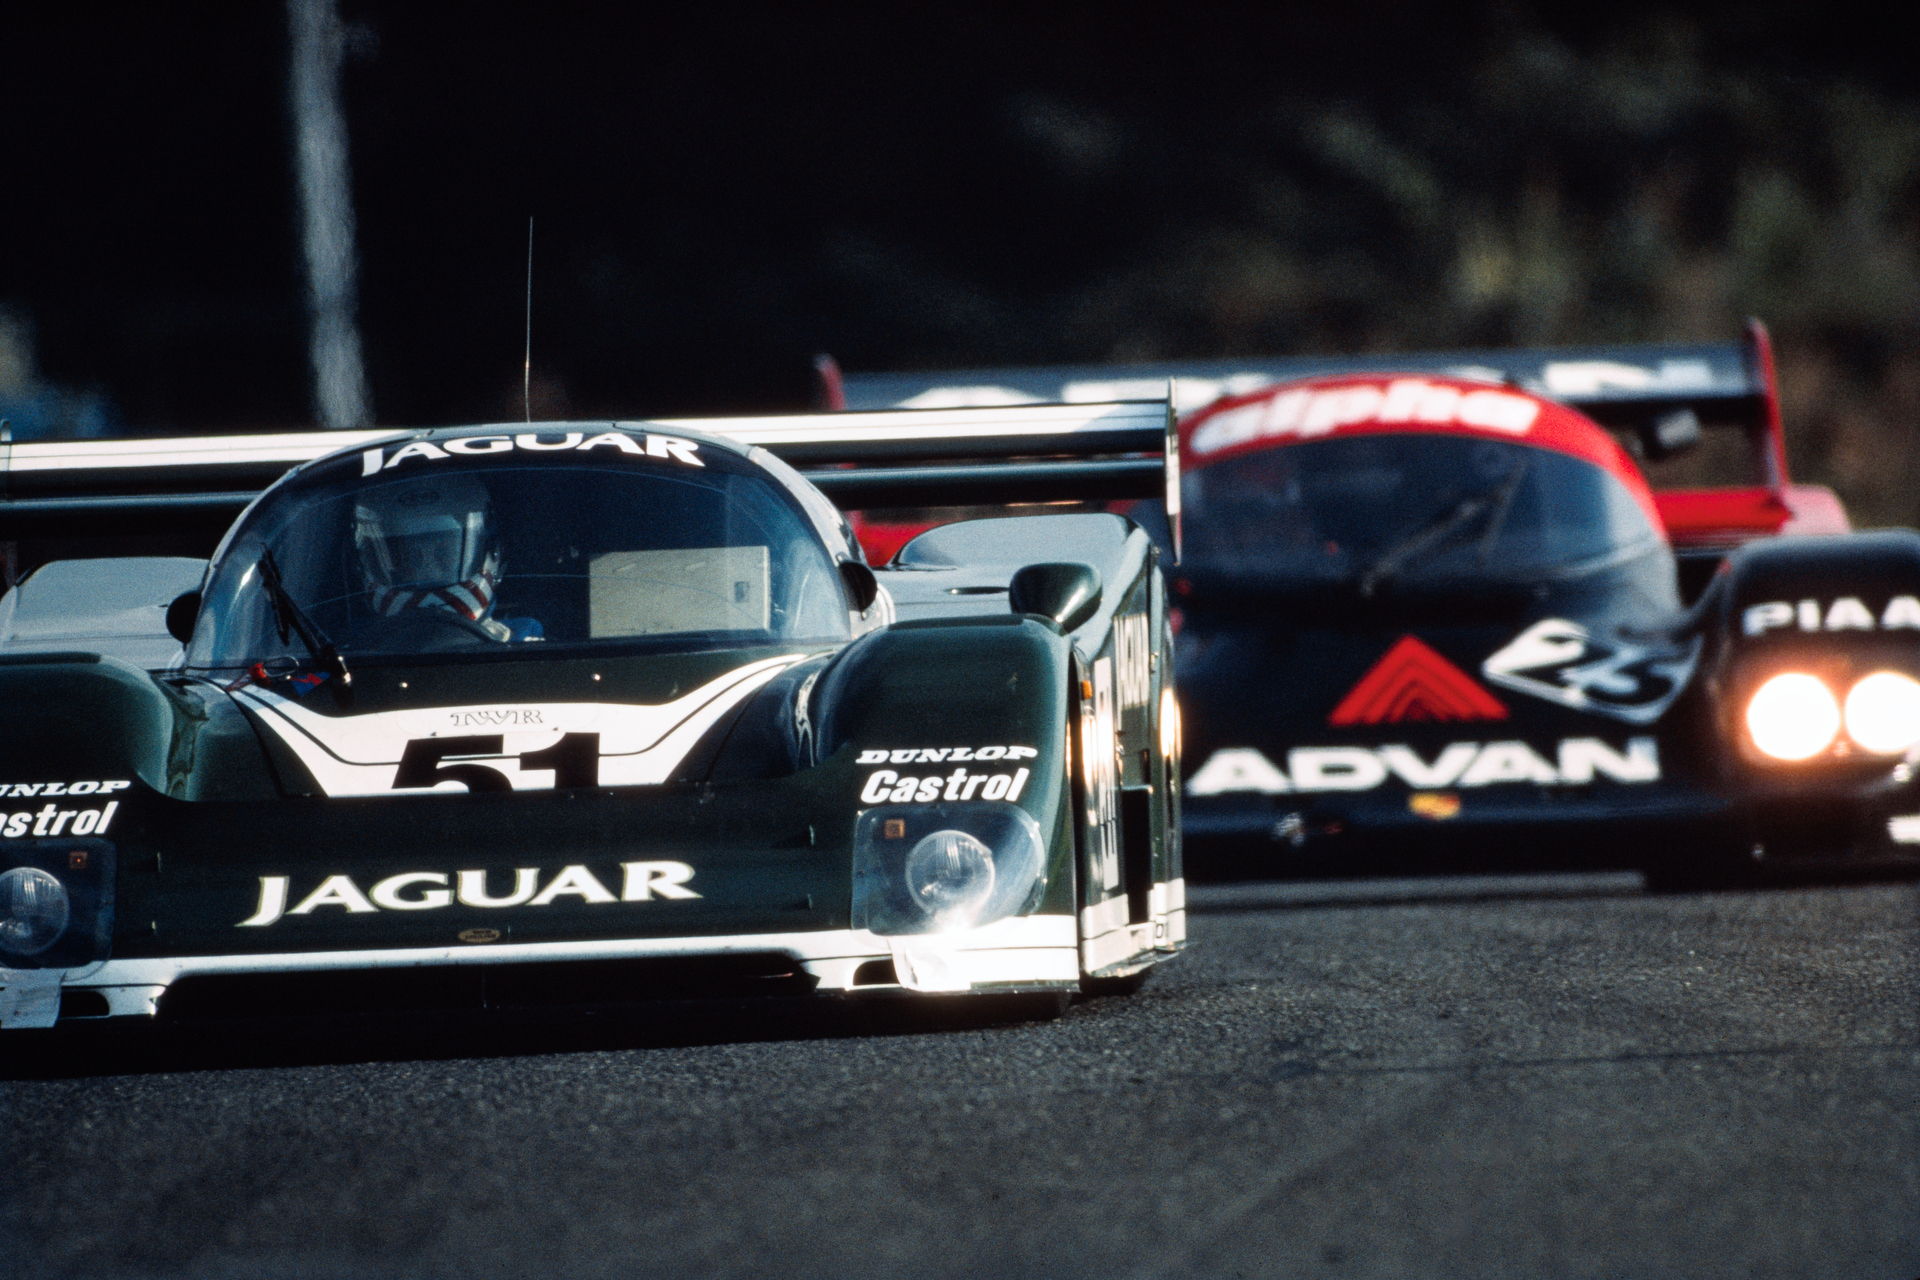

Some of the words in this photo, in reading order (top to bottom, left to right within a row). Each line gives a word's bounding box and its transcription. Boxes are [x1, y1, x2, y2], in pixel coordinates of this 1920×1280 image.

[1190, 379, 1540, 455] alpha
[362, 432, 706, 477] JAGUAR
[1741, 596, 1920, 636] PIAA
[450, 709, 543, 727] TWR
[391, 731, 600, 793] 51
[855, 746, 1038, 764] DUNLOP
[1187, 737, 1661, 796] ADVAN
[860, 767, 1030, 804] Castrol
[0, 801, 119, 837] strol
[234, 861, 702, 927] JAGUAR
